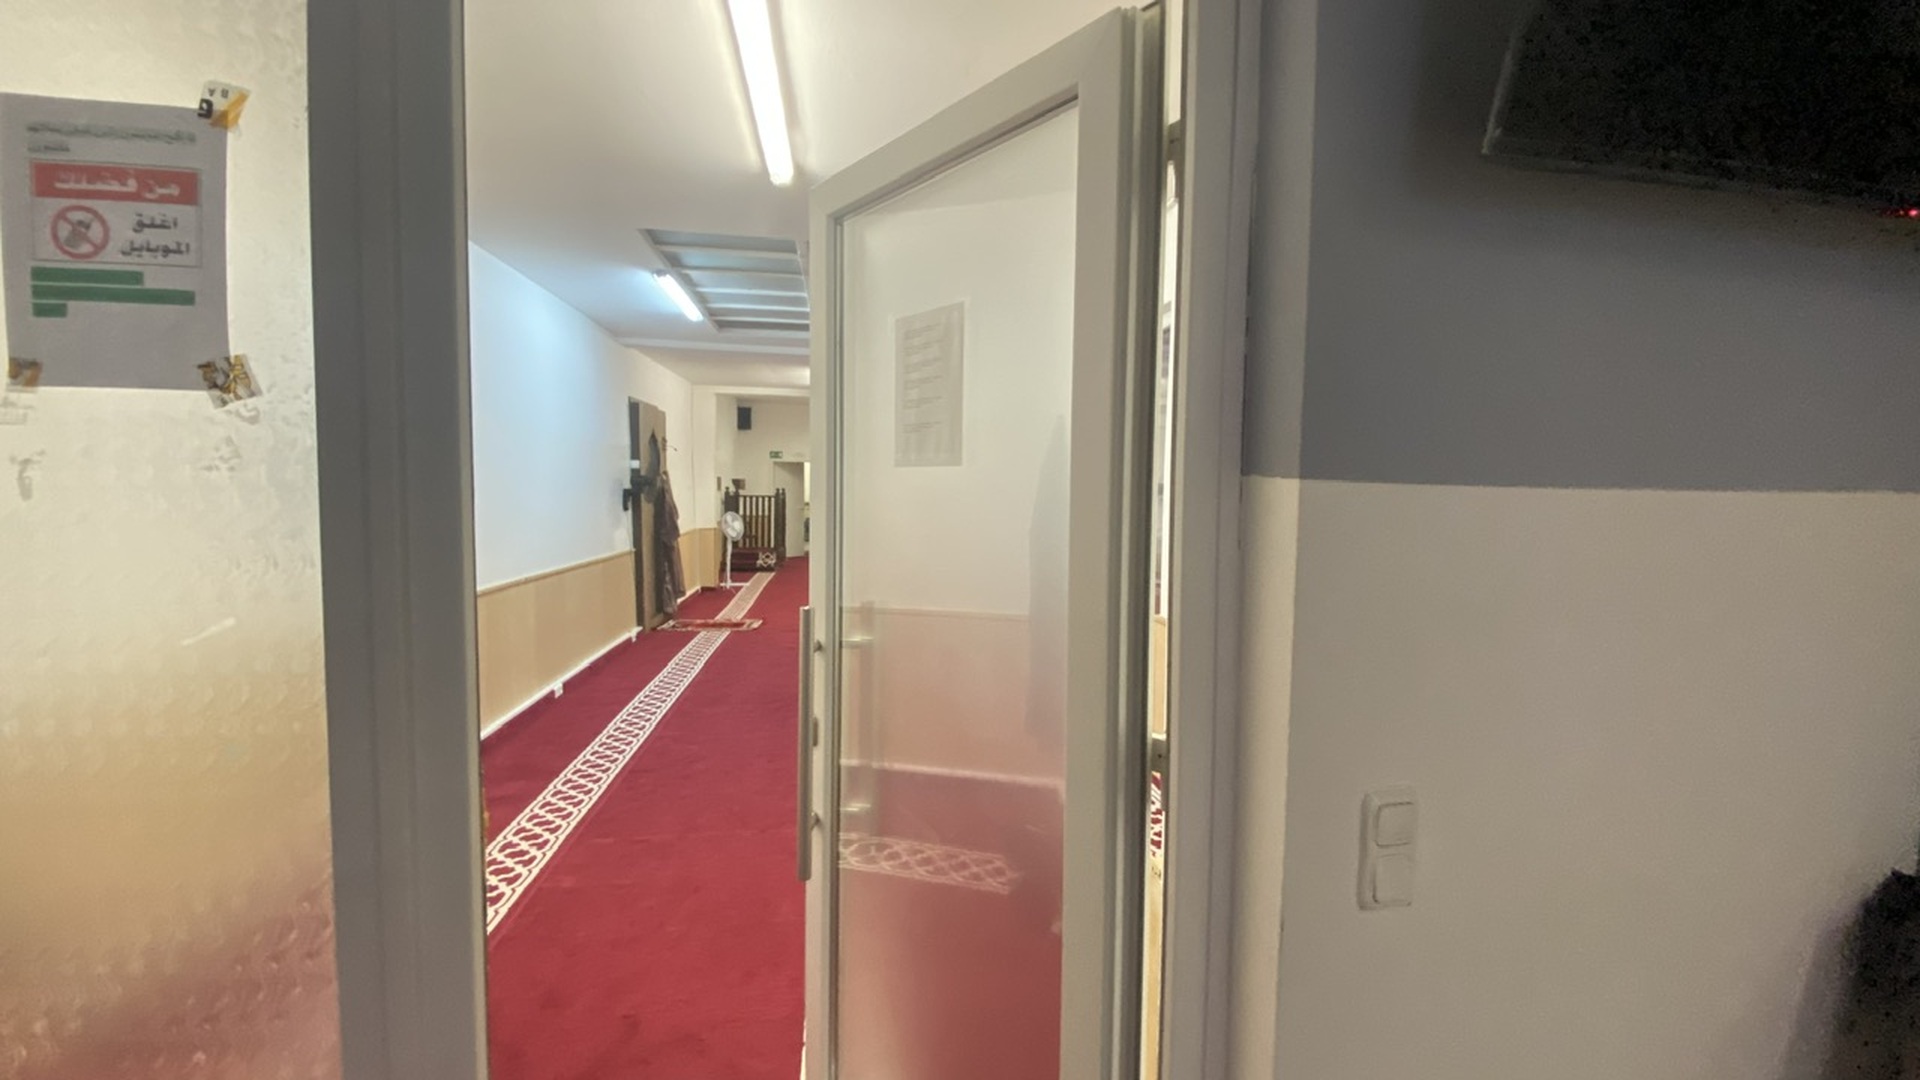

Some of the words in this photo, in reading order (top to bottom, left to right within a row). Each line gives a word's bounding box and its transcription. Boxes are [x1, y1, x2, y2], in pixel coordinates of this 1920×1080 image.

[53, 169, 139, 192] فضلك
[142, 178, 181, 199] من
[120, 240, 190, 259] الموبايل
